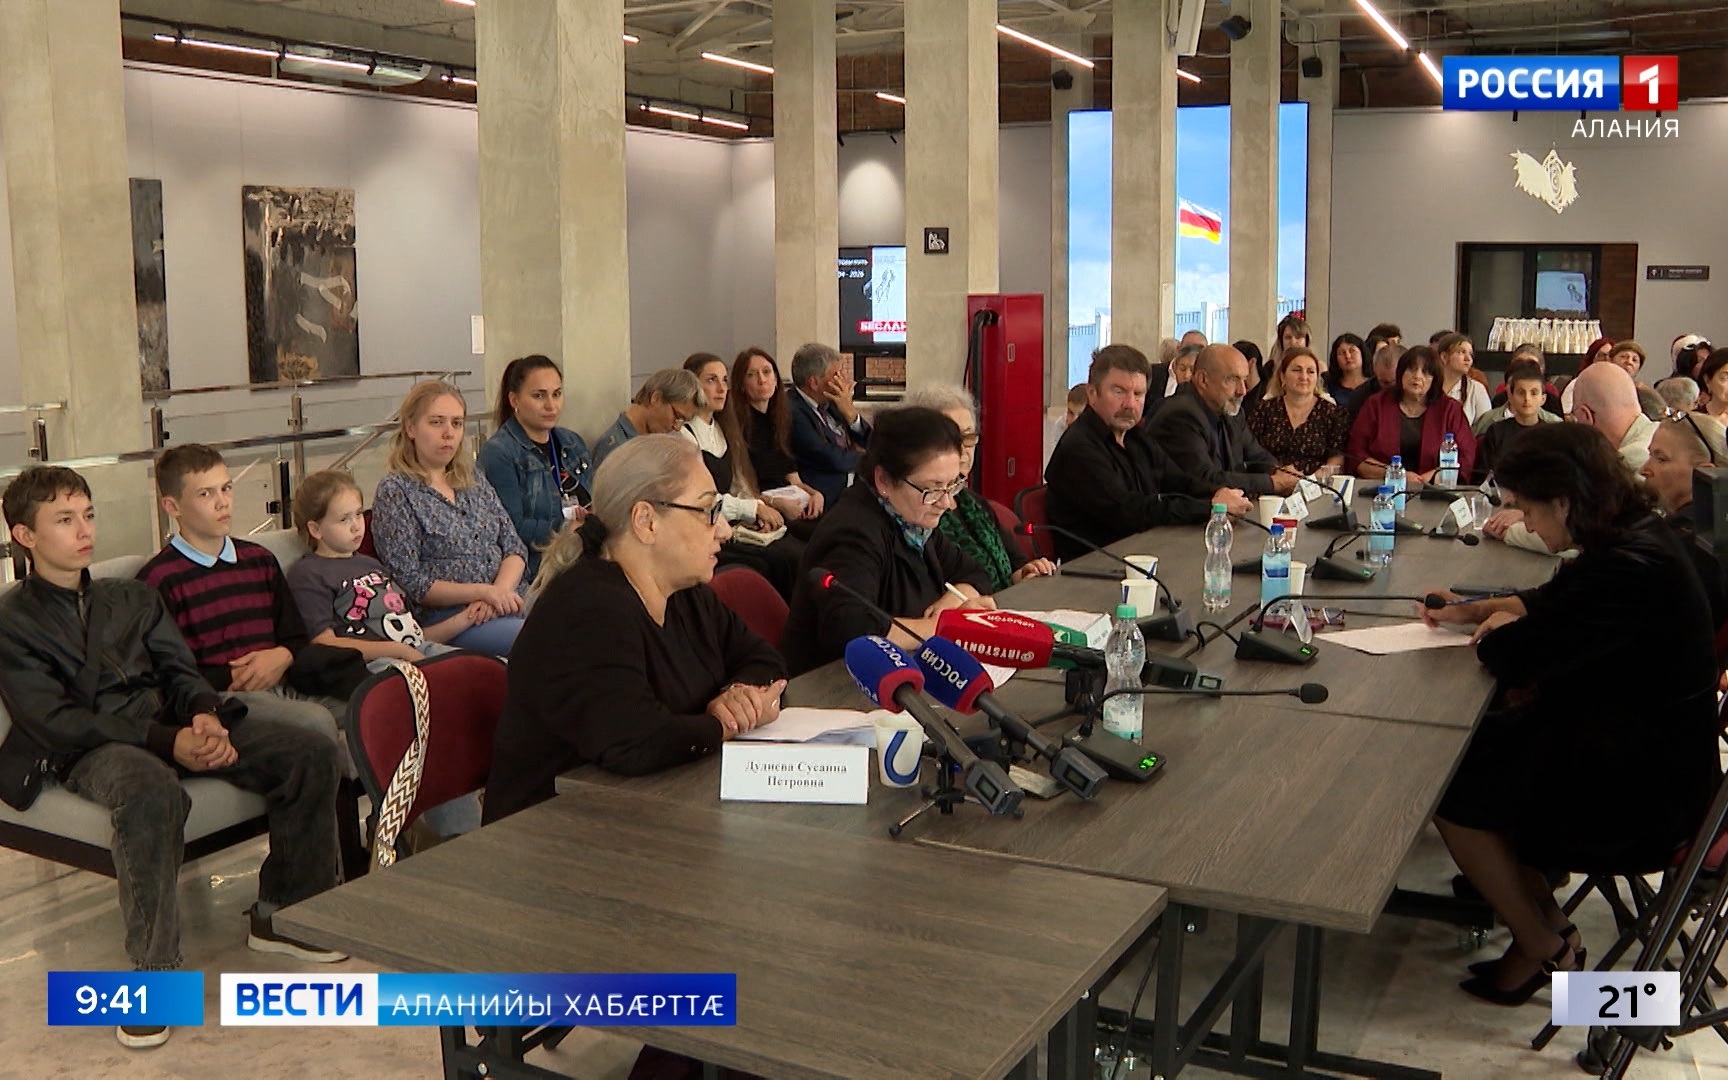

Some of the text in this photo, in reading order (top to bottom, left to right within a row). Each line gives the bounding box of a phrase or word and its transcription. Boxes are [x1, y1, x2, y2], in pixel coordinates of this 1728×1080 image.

[920, 647, 968, 690] РОССИЯ
[797, 761, 847, 775] Сусанна
[767, 776, 824, 789] Петровна
